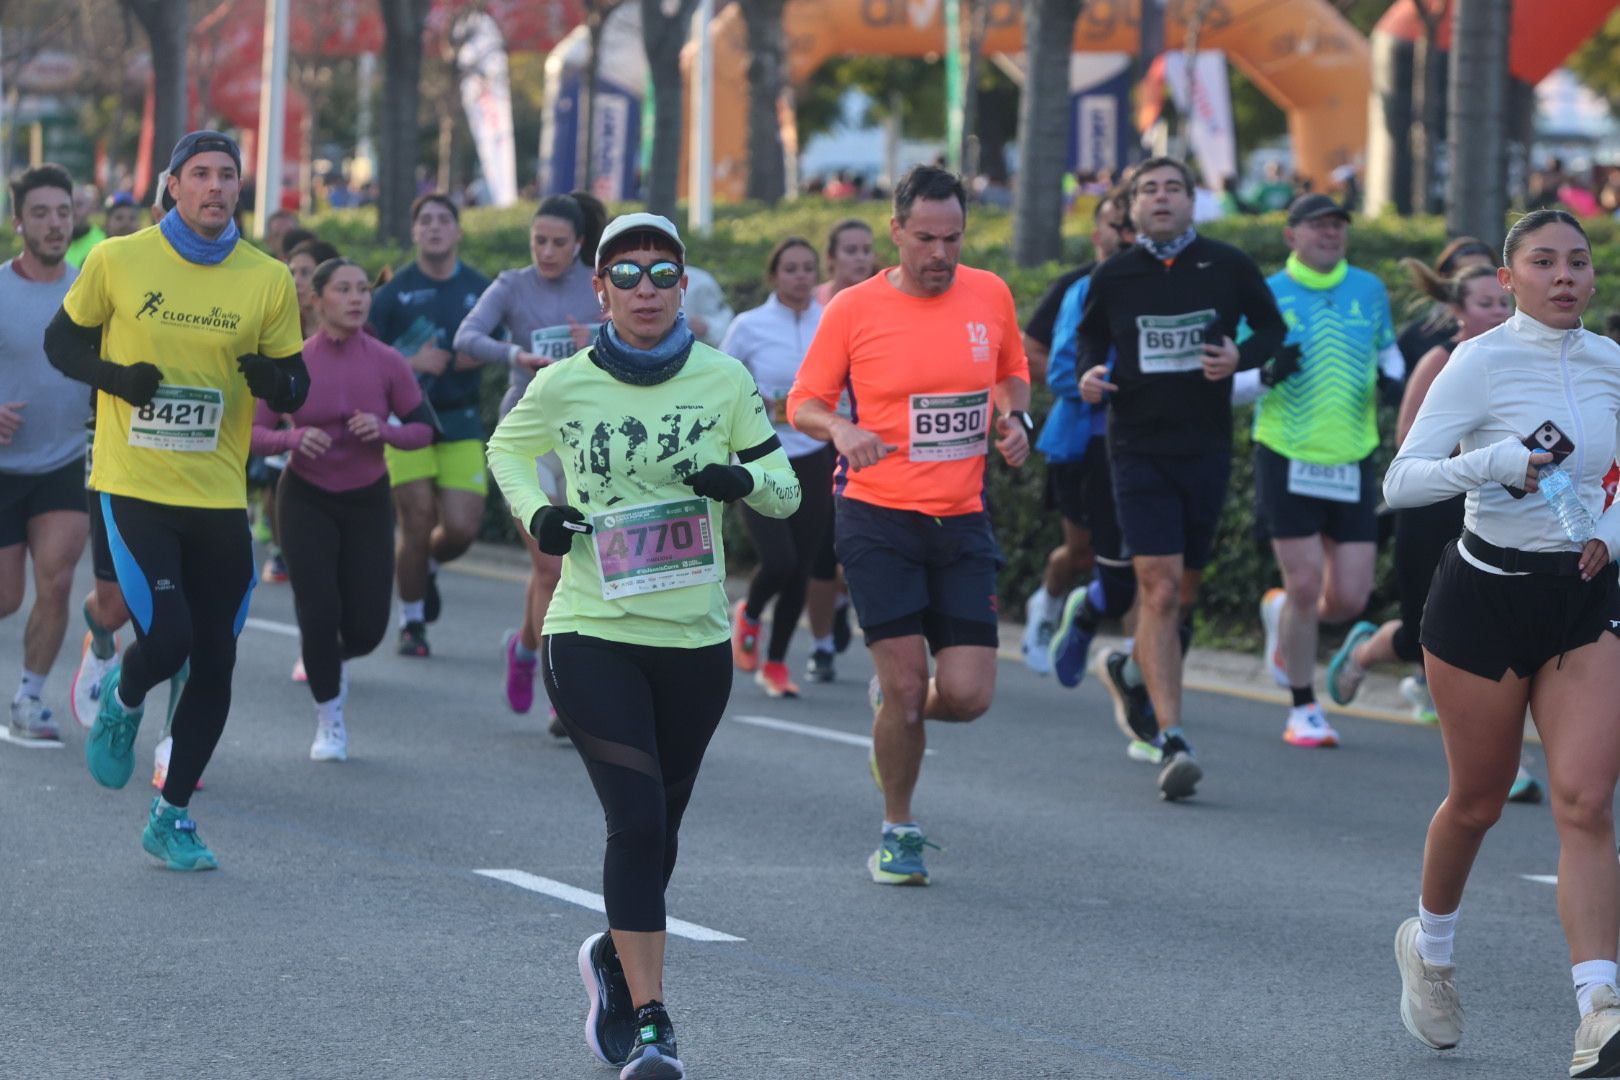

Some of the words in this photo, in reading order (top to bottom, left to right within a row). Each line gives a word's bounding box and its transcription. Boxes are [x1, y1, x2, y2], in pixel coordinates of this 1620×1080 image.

[162, 310, 238, 329] CLOCKWORK
[966, 321, 989, 345] 12
[1146, 327, 1204, 349] 6670
[137, 401, 206, 425] 8421
[916, 409, 981, 435] 6930
[606, 520, 694, 560] 4770
